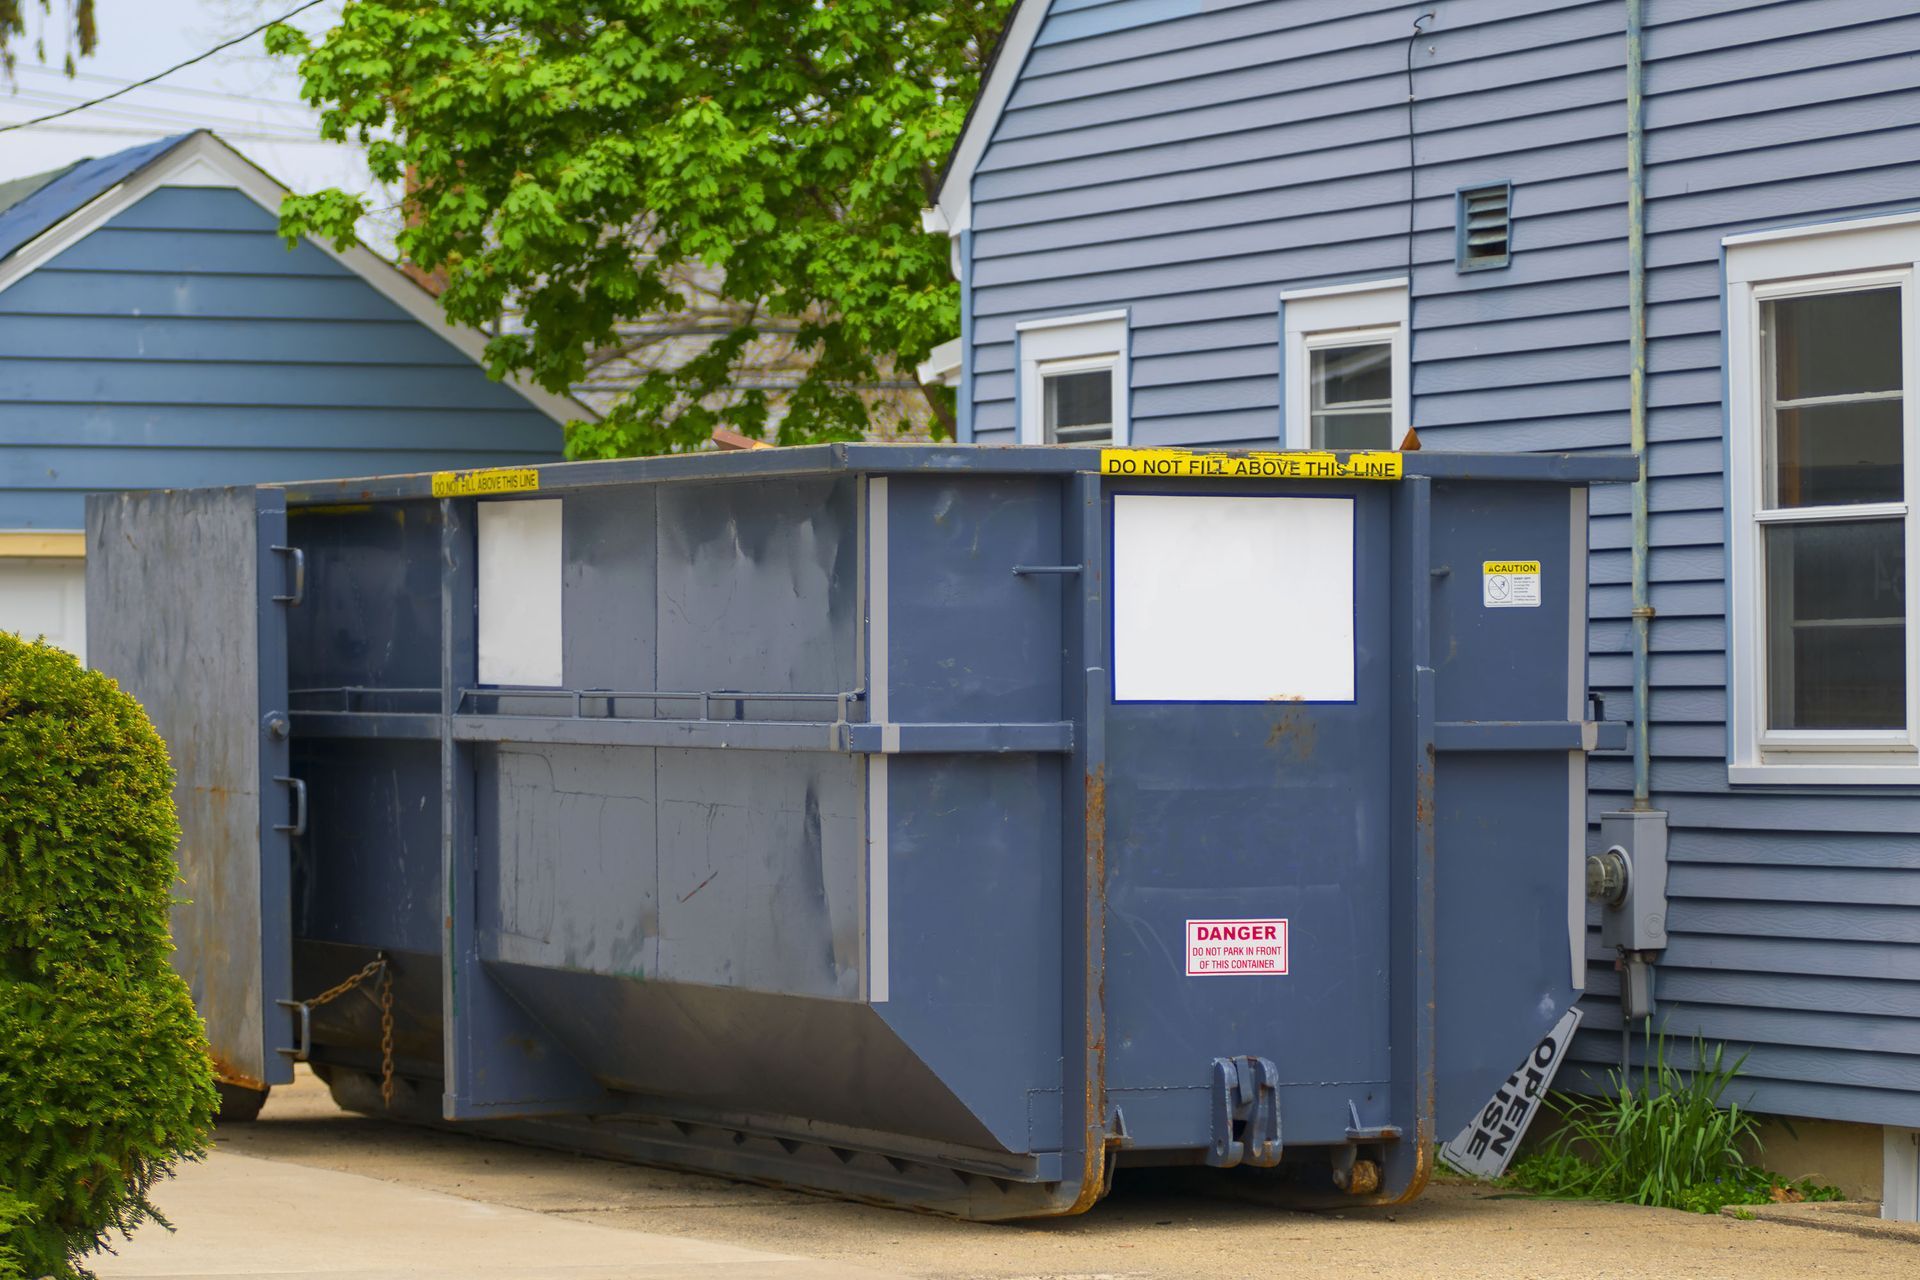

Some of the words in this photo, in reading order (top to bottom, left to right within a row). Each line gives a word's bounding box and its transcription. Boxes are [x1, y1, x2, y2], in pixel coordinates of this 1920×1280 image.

[1109, 459, 1137, 474] DO
[1143, 460, 1182, 475] NOT
[1189, 460, 1228, 475] FILL
[1235, 461, 1301, 476] ABOVE
[1305, 462, 1347, 476] THIS
[1354, 462, 1395, 477] LINE
[434, 481, 445, 495] DO
[446, 479, 460, 493] NOT
[478, 476, 501, 490] ABOVE
[502, 475, 518, 488] THIS
[519, 473, 536, 487] LINE
[1494, 564, 1537, 573] CAUTION
[1197, 926, 1277, 940] DANGER
[1192, 947, 1204, 956] DO
[1205, 947, 1222, 956] NOT
[1223, 947, 1244, 956] PARK
[1246, 946, 1254, 955] IN
[1256, 946, 1282, 955] FRONT
[1199, 960, 1210, 969] OF
[1212, 960, 1230, 969] THIS
[1231, 960, 1275, 969] CONTAINER
[1490, 1037, 1556, 1157] OPEN
